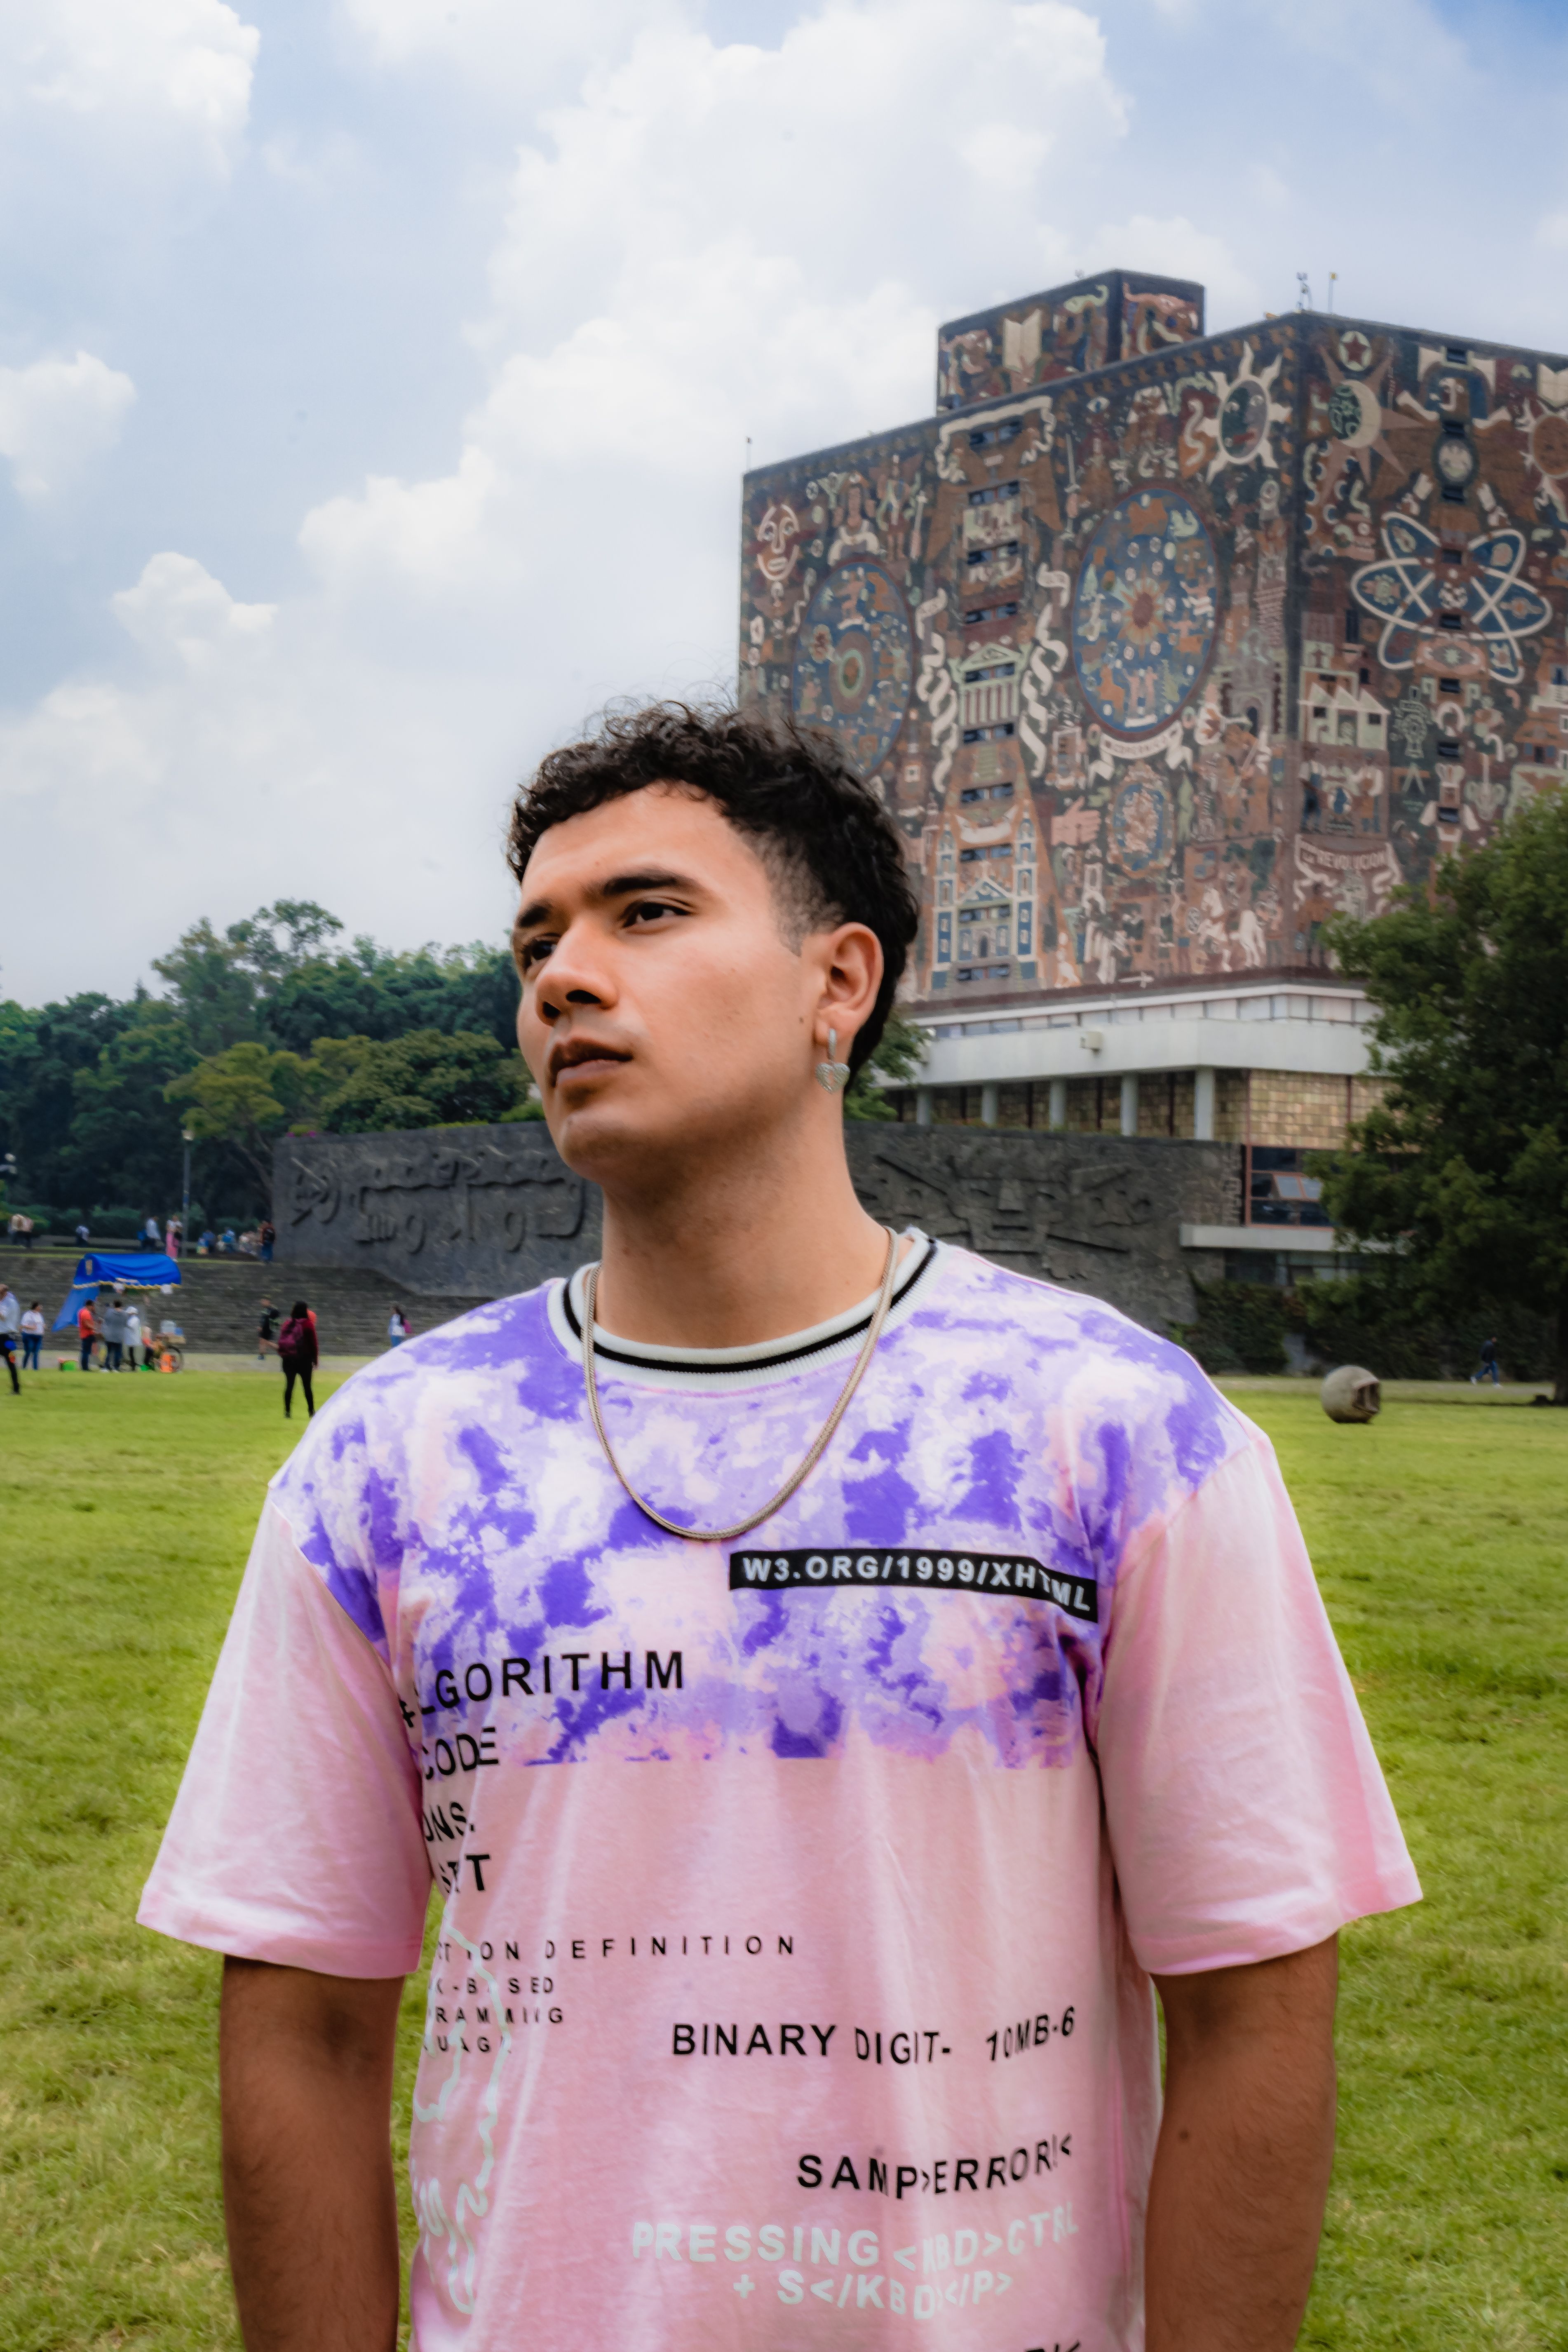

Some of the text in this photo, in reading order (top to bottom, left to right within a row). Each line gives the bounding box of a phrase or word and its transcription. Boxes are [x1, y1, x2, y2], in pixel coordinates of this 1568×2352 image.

[742, 1555, 1091, 1611] W3.ORG/1999/XHTML
[545, 1936, 794, 1960] DEFINITION
[673, 2023, 836, 2056] BINARY
[633, 2222, 879, 2267] PRESSING
